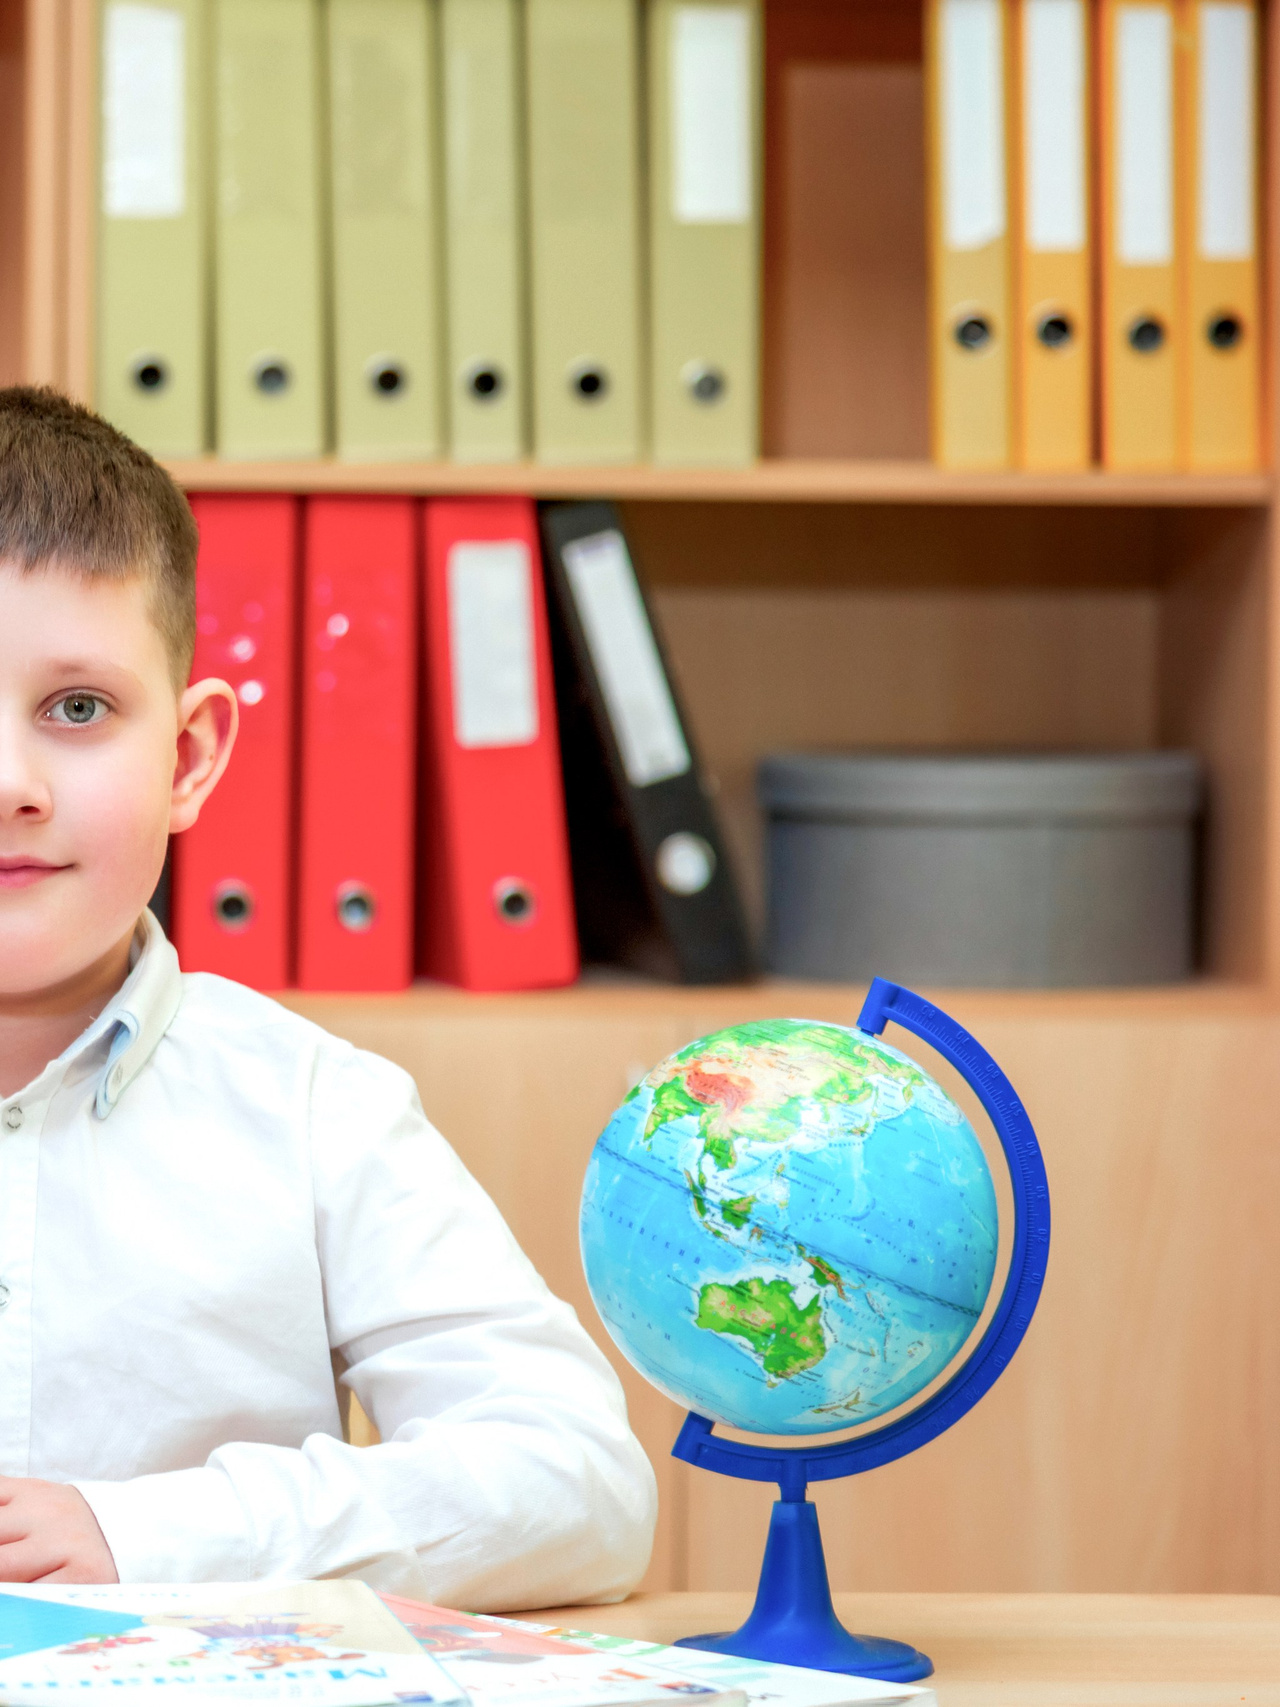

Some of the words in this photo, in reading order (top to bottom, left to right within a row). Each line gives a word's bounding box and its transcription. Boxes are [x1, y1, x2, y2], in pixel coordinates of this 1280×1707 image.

[921, 1004, 936, 1019] 80
[955, 1030, 971, 1046] 70
[985, 1063, 1000, 1079] 60
[1009, 1100, 1023, 1116] 50
[1025, 1141, 1039, 1156] 40
[1035, 1185, 1047, 1200] 30
[1037, 1228, 1048, 1243] 20
[1030, 1272, 1042, 1285] 10
